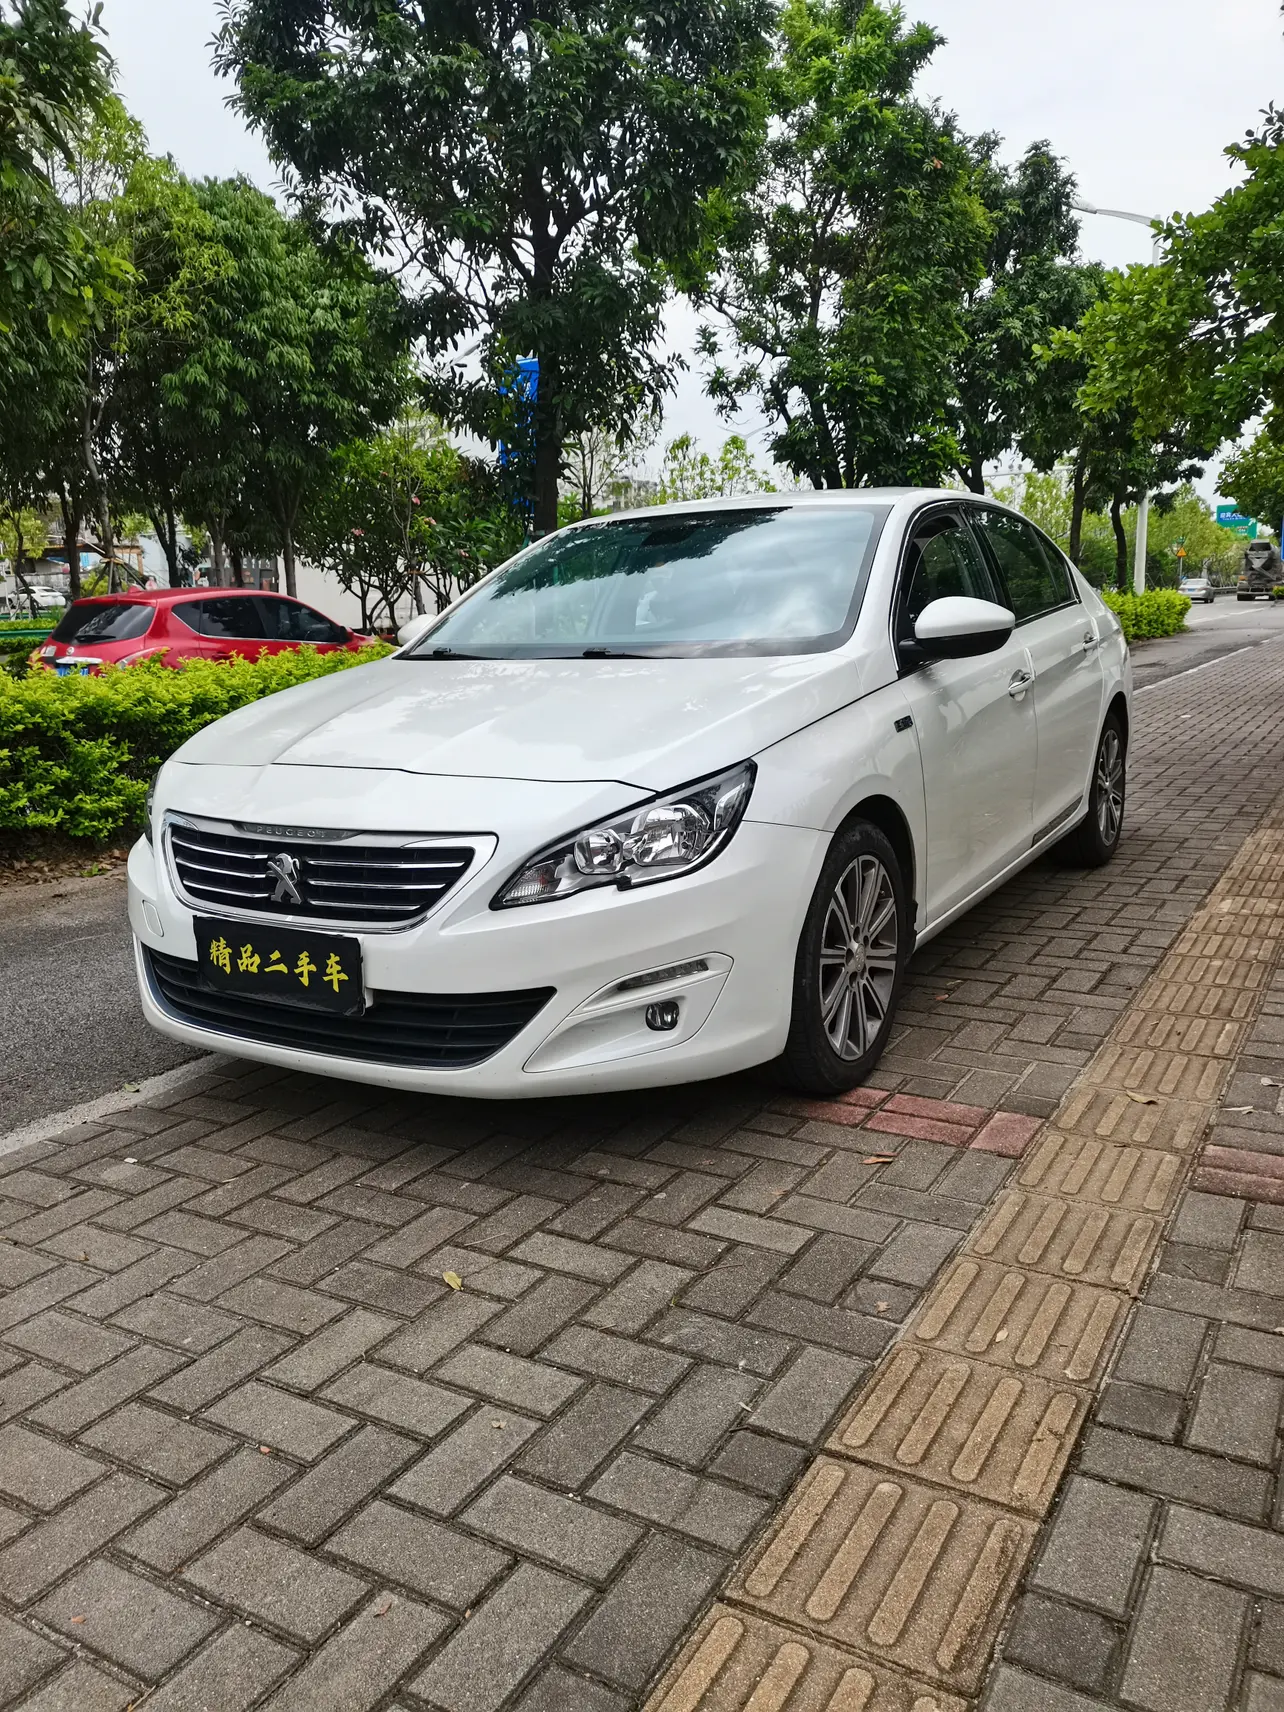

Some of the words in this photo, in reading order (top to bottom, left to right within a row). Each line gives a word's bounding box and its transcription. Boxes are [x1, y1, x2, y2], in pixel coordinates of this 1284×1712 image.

[256, 825, 326, 838] PEUGEOT
[209, 936, 349, 993] 精品二手车
